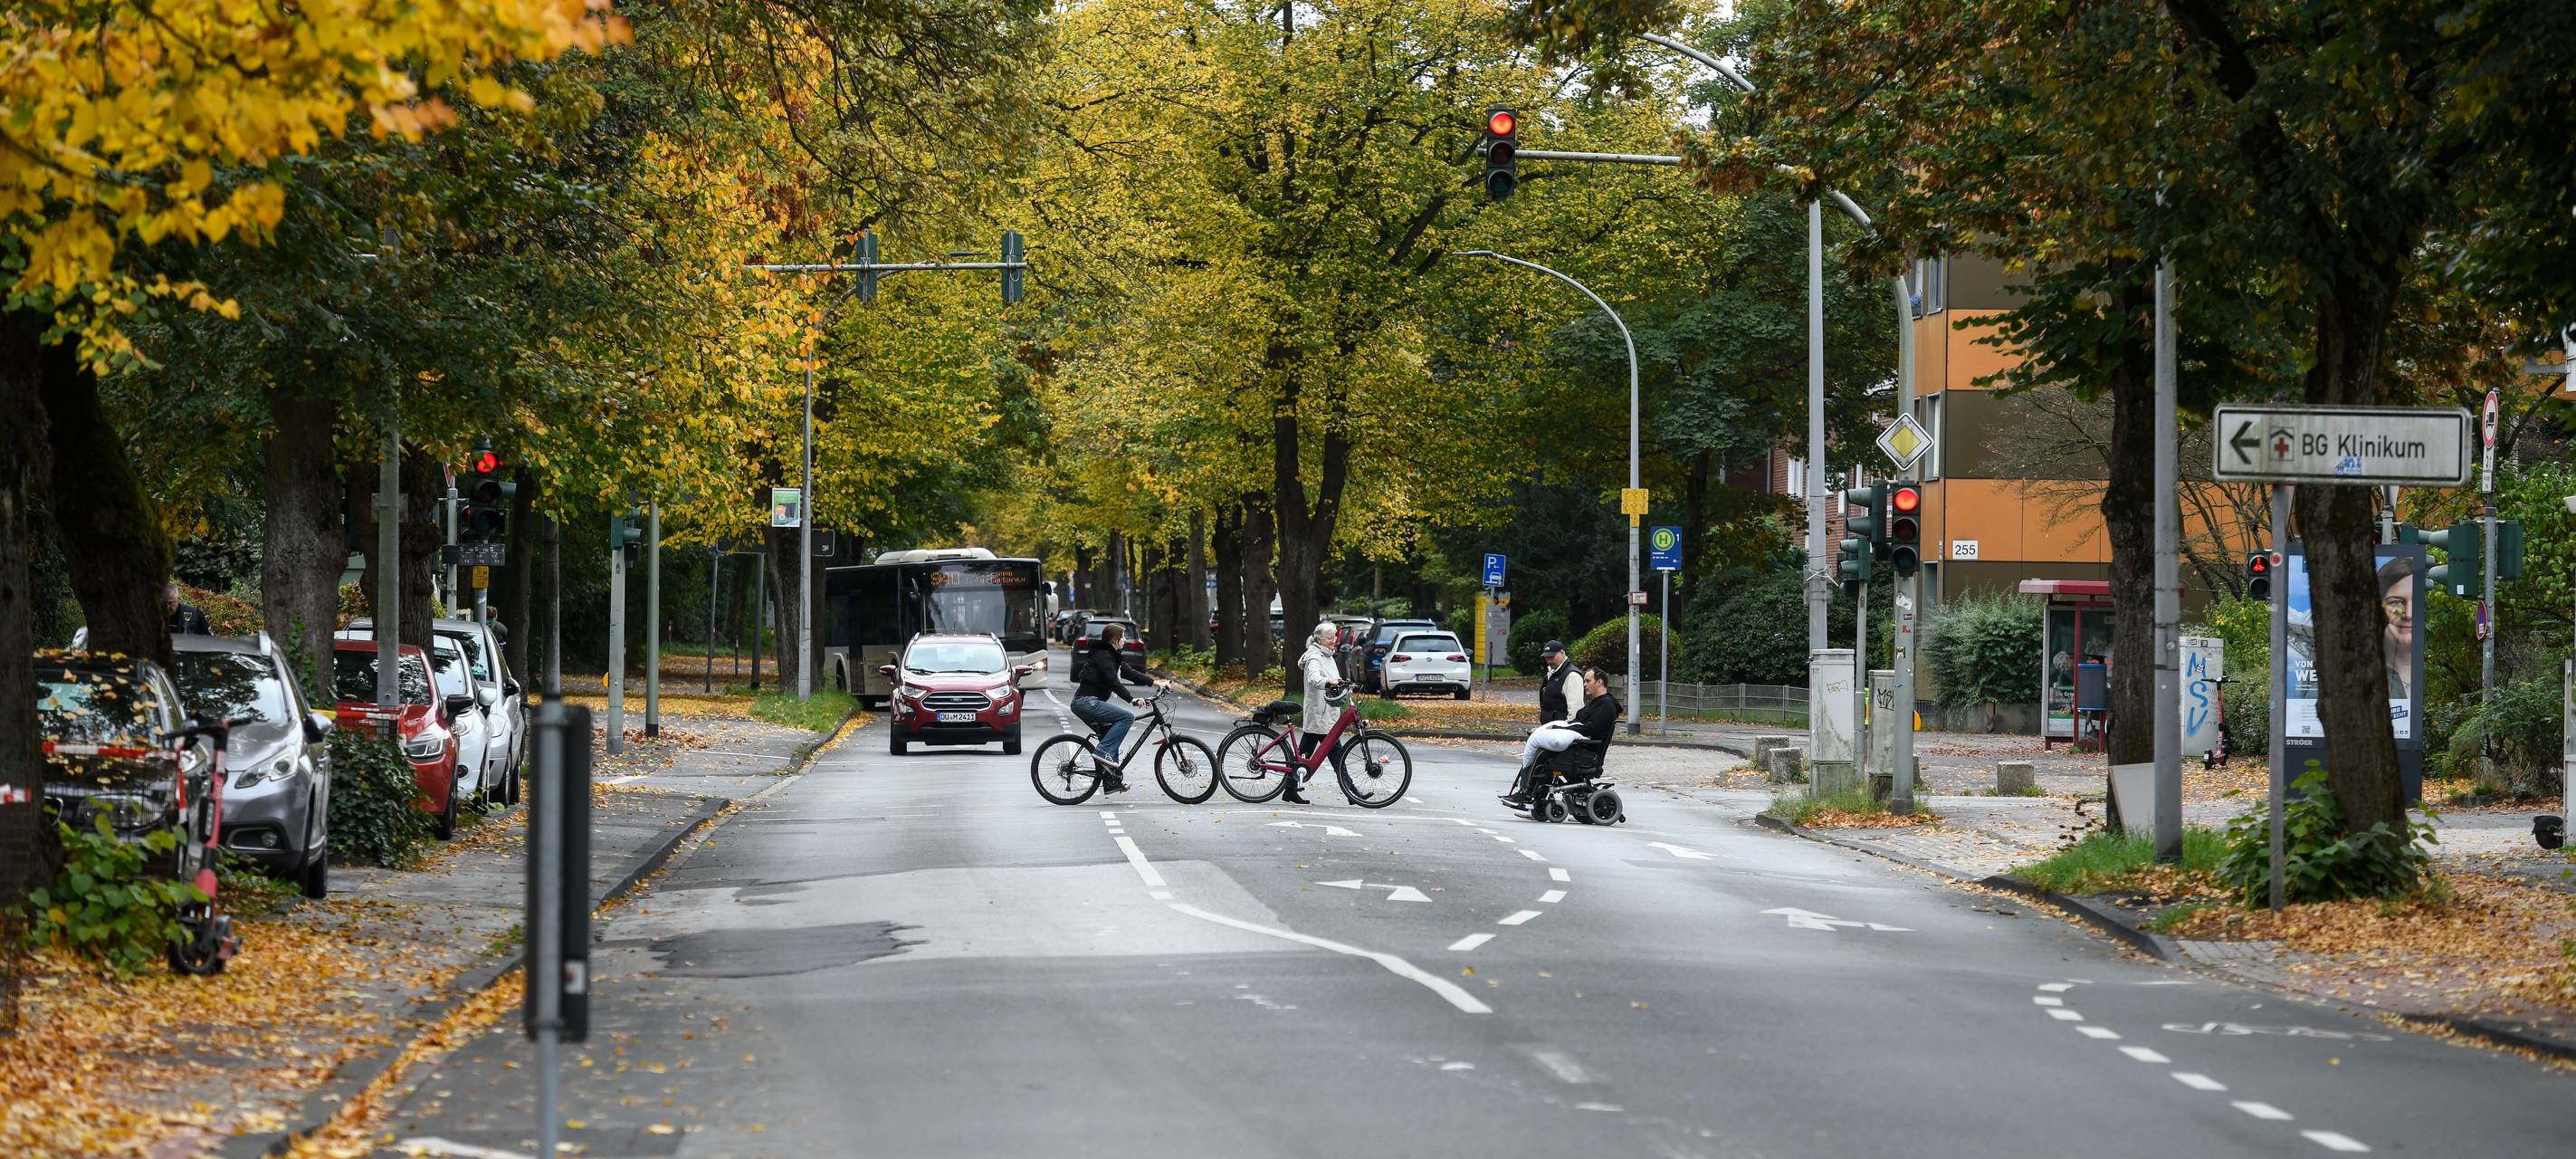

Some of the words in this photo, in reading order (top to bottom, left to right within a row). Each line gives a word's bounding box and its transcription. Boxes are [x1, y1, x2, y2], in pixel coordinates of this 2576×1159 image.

[2302, 433, 2328, 456] BG
[2338, 434, 2426, 459] Klinikum
[1675, 533, 1680, 542] 1
[1955, 544, 1976, 555] 255
[1487, 556, 1497, 569] P
[2295, 660, 2314, 668] VON
